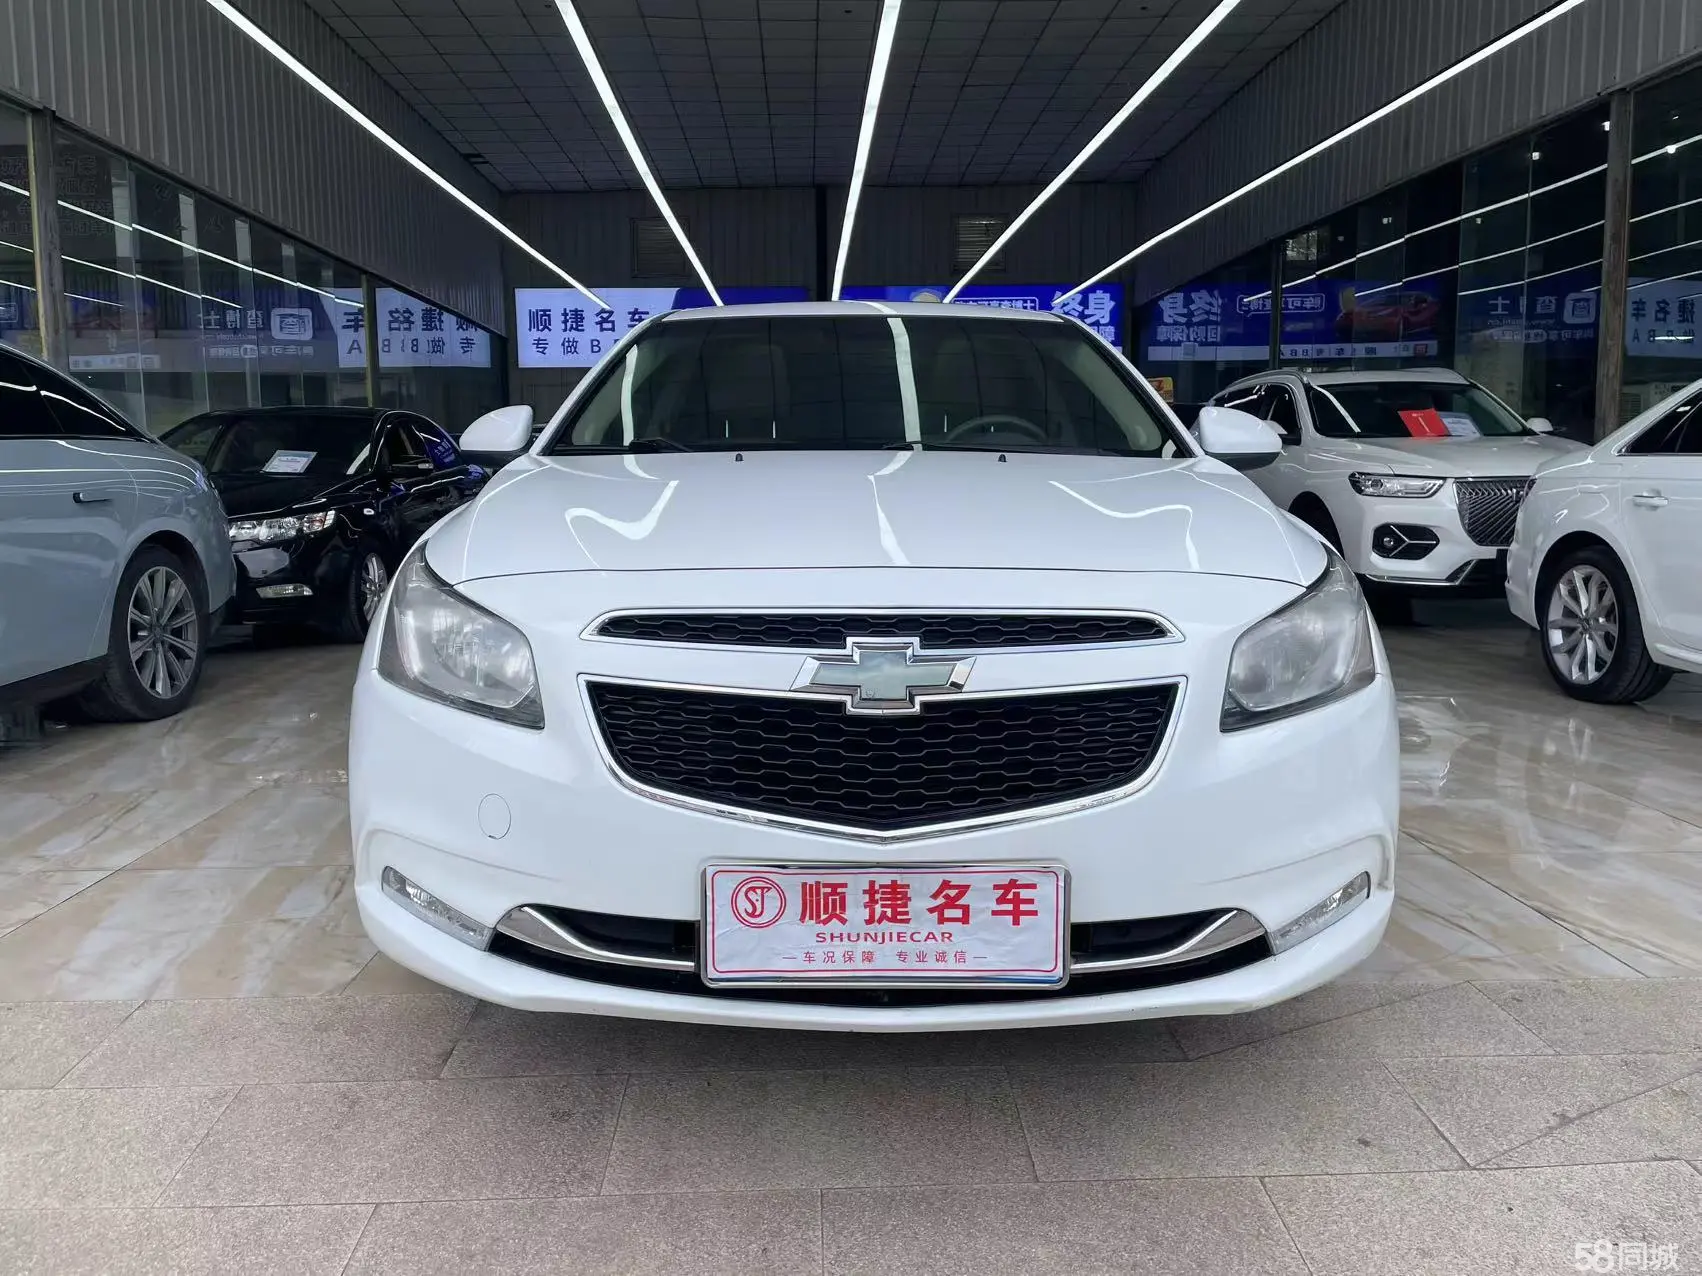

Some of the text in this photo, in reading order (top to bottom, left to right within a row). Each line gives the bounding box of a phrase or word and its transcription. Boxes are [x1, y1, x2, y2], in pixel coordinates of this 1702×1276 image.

[1051, 290, 1116, 325] 终身
[799, 879, 1039, 926] 顺捷名车
[815, 931, 954, 944] SHUNJIECAR
[802, 950, 968, 964] 车况保障 专业诚信
